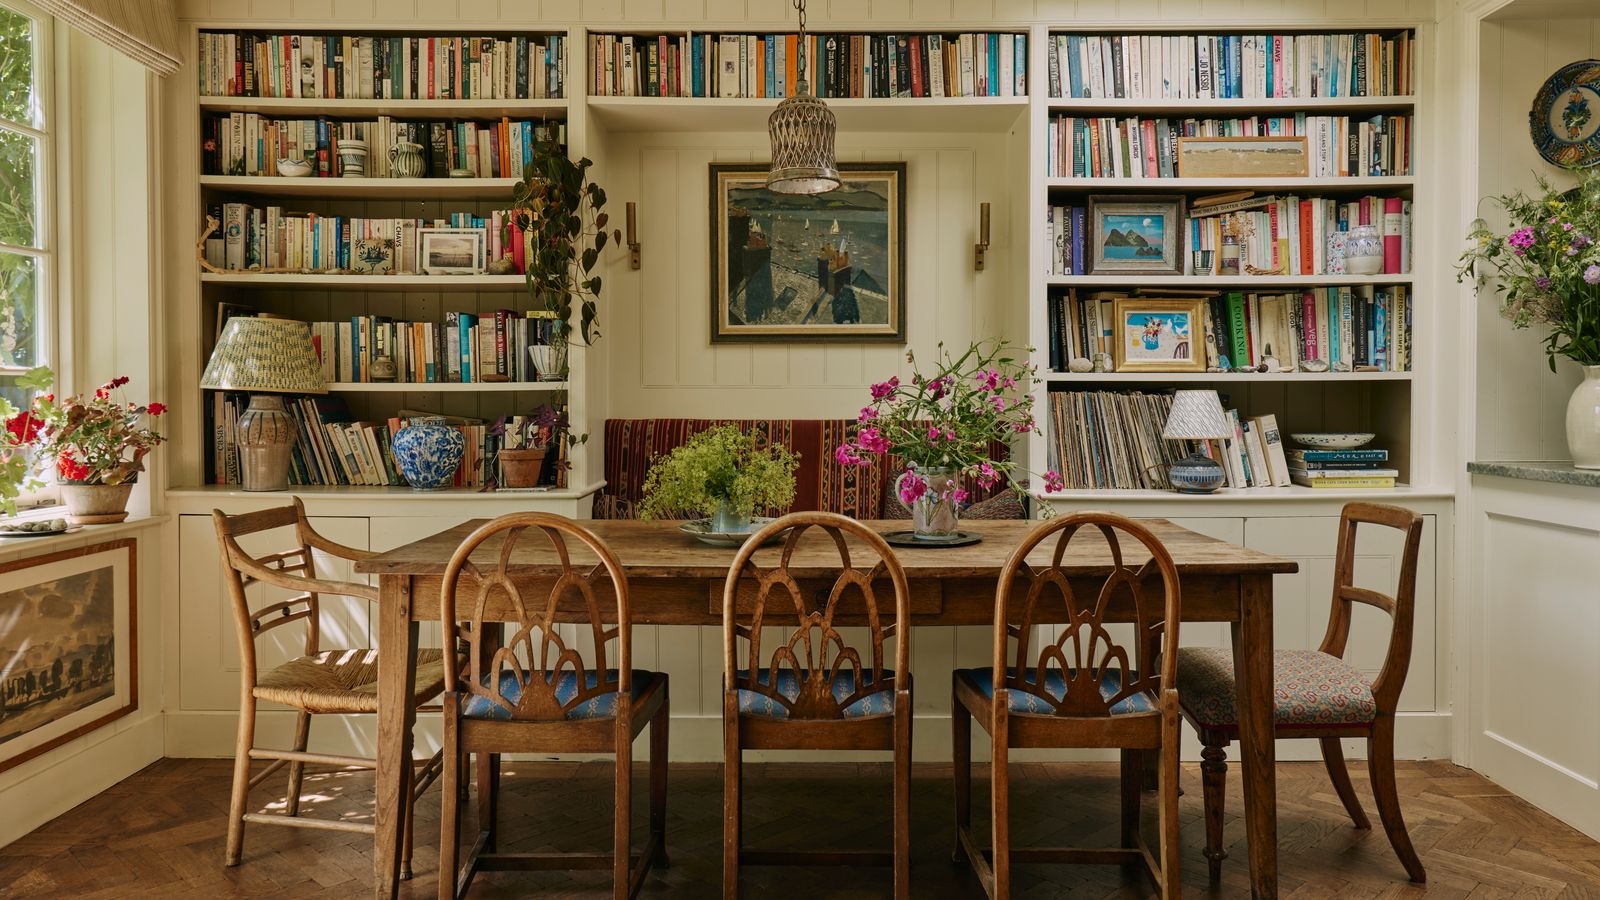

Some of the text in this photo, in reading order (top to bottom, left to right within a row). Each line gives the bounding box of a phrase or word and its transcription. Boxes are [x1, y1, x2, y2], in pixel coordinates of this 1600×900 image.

[1200, 59, 1208, 68] JO
[1349, 134, 1358, 155] gideon
[1234, 306, 1245, 355] COOKING
[1306, 328, 1316, 346] veg
